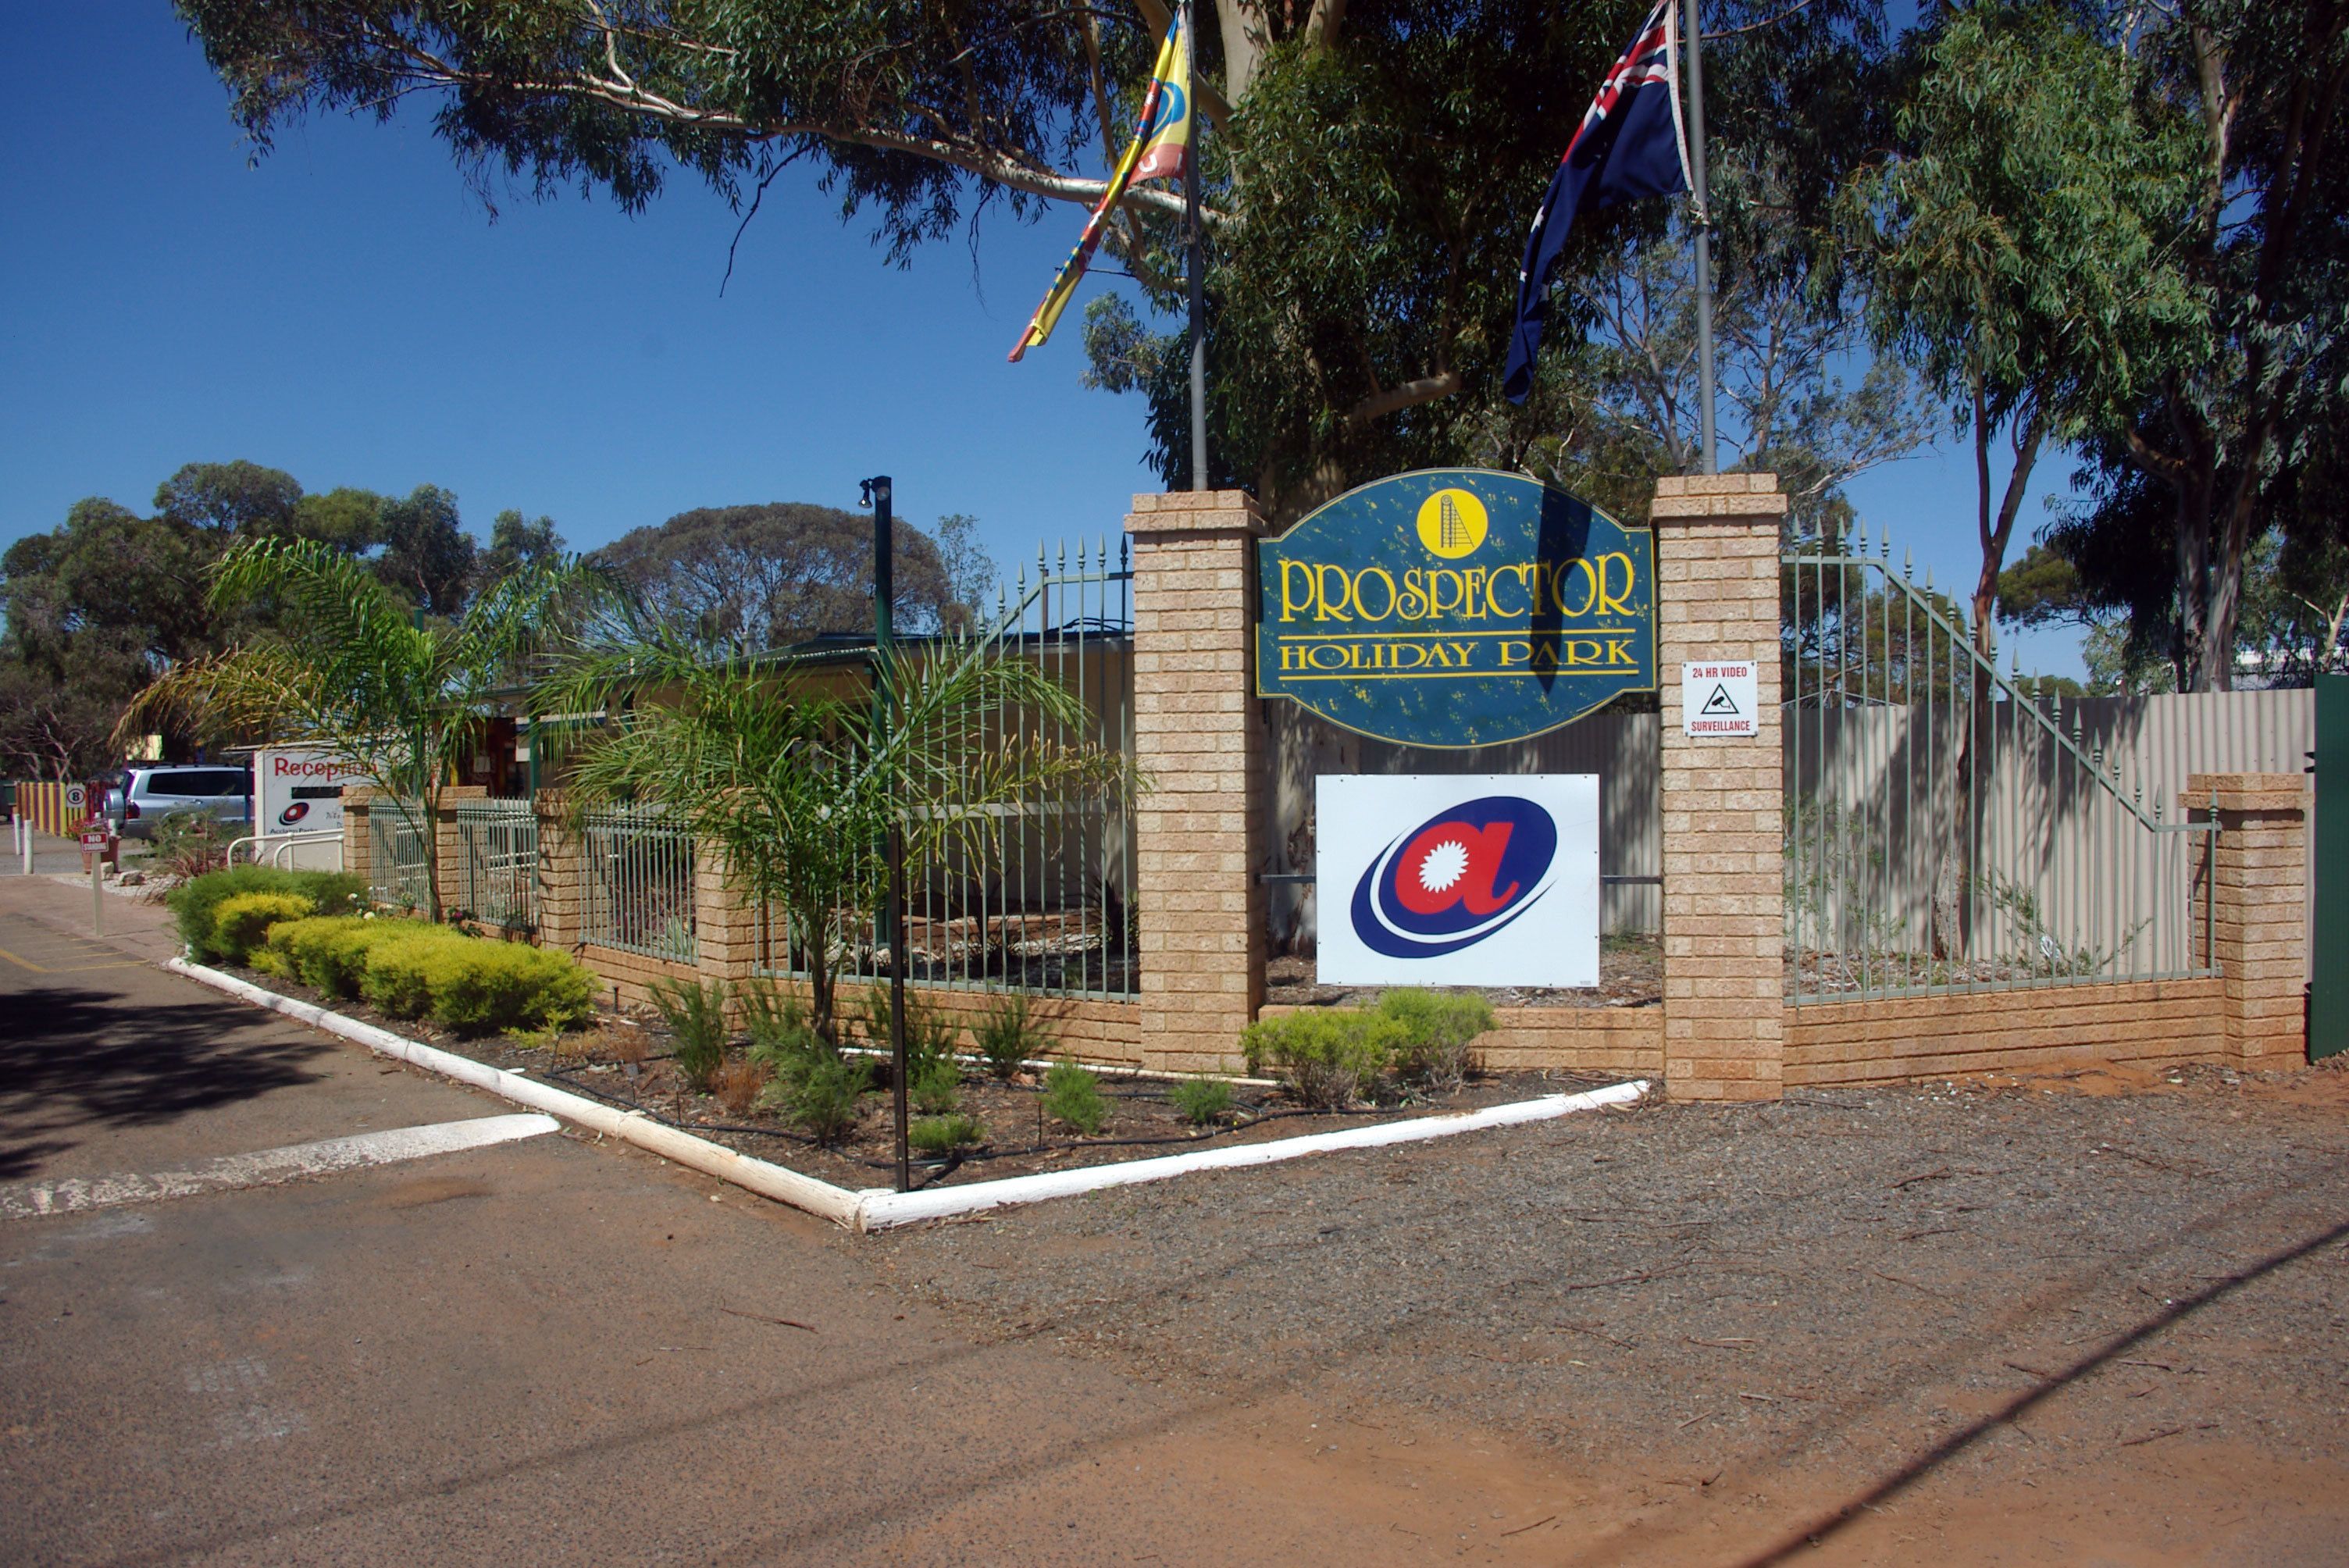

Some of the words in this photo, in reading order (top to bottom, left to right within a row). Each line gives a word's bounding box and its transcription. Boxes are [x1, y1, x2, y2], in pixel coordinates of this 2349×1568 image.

[1278, 551, 1637, 623] PROSPECTOR
[1279, 642, 1478, 670] HOLIDAY
[1499, 640, 1638, 667] PARK
[1692, 668, 1702, 678] 24
[1706, 667, 1718, 678] HR
[1721, 667, 1747, 677] VIDEO
[1691, 720, 1751, 732] SURVEILLANCE
[72, 792, 80, 801] 8
